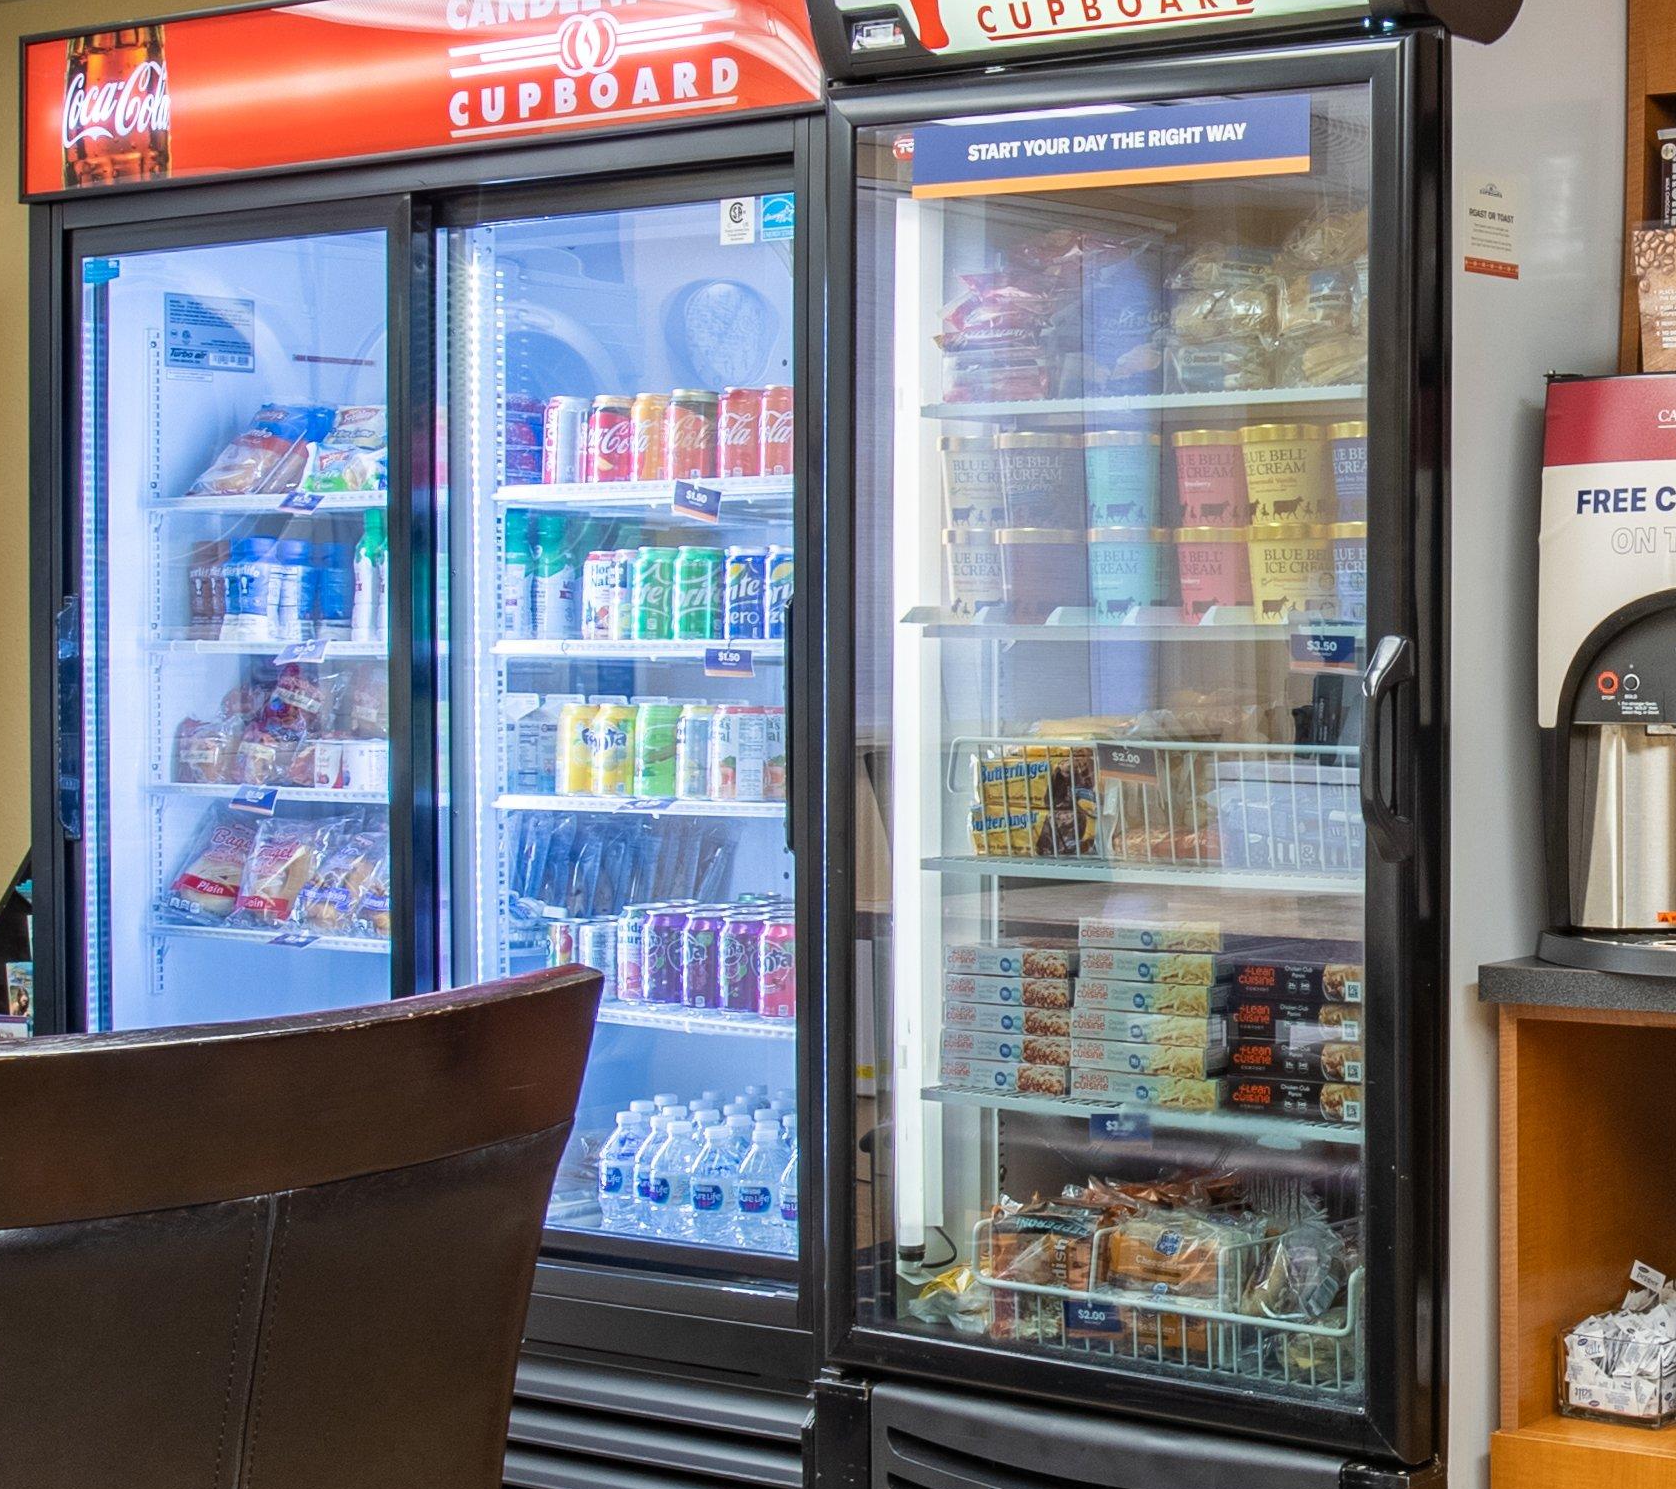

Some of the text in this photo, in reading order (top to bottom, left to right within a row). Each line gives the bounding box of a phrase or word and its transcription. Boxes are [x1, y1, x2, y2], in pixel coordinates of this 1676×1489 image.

[62, 61, 171, 149] Coca-Cola
[449, 57, 738, 126] CUPBOARD
[968, 123, 1247, 162] START YOUR DAY THE RIGHT WAY
[1577, 486, 1646, 514] FREE
[1611, 526, 1657, 554] ON
[1112, 752, 1140, 764] $2.00
[196, 879, 224, 894] Plain
[1078, 1310, 1106, 1322] $2.00
